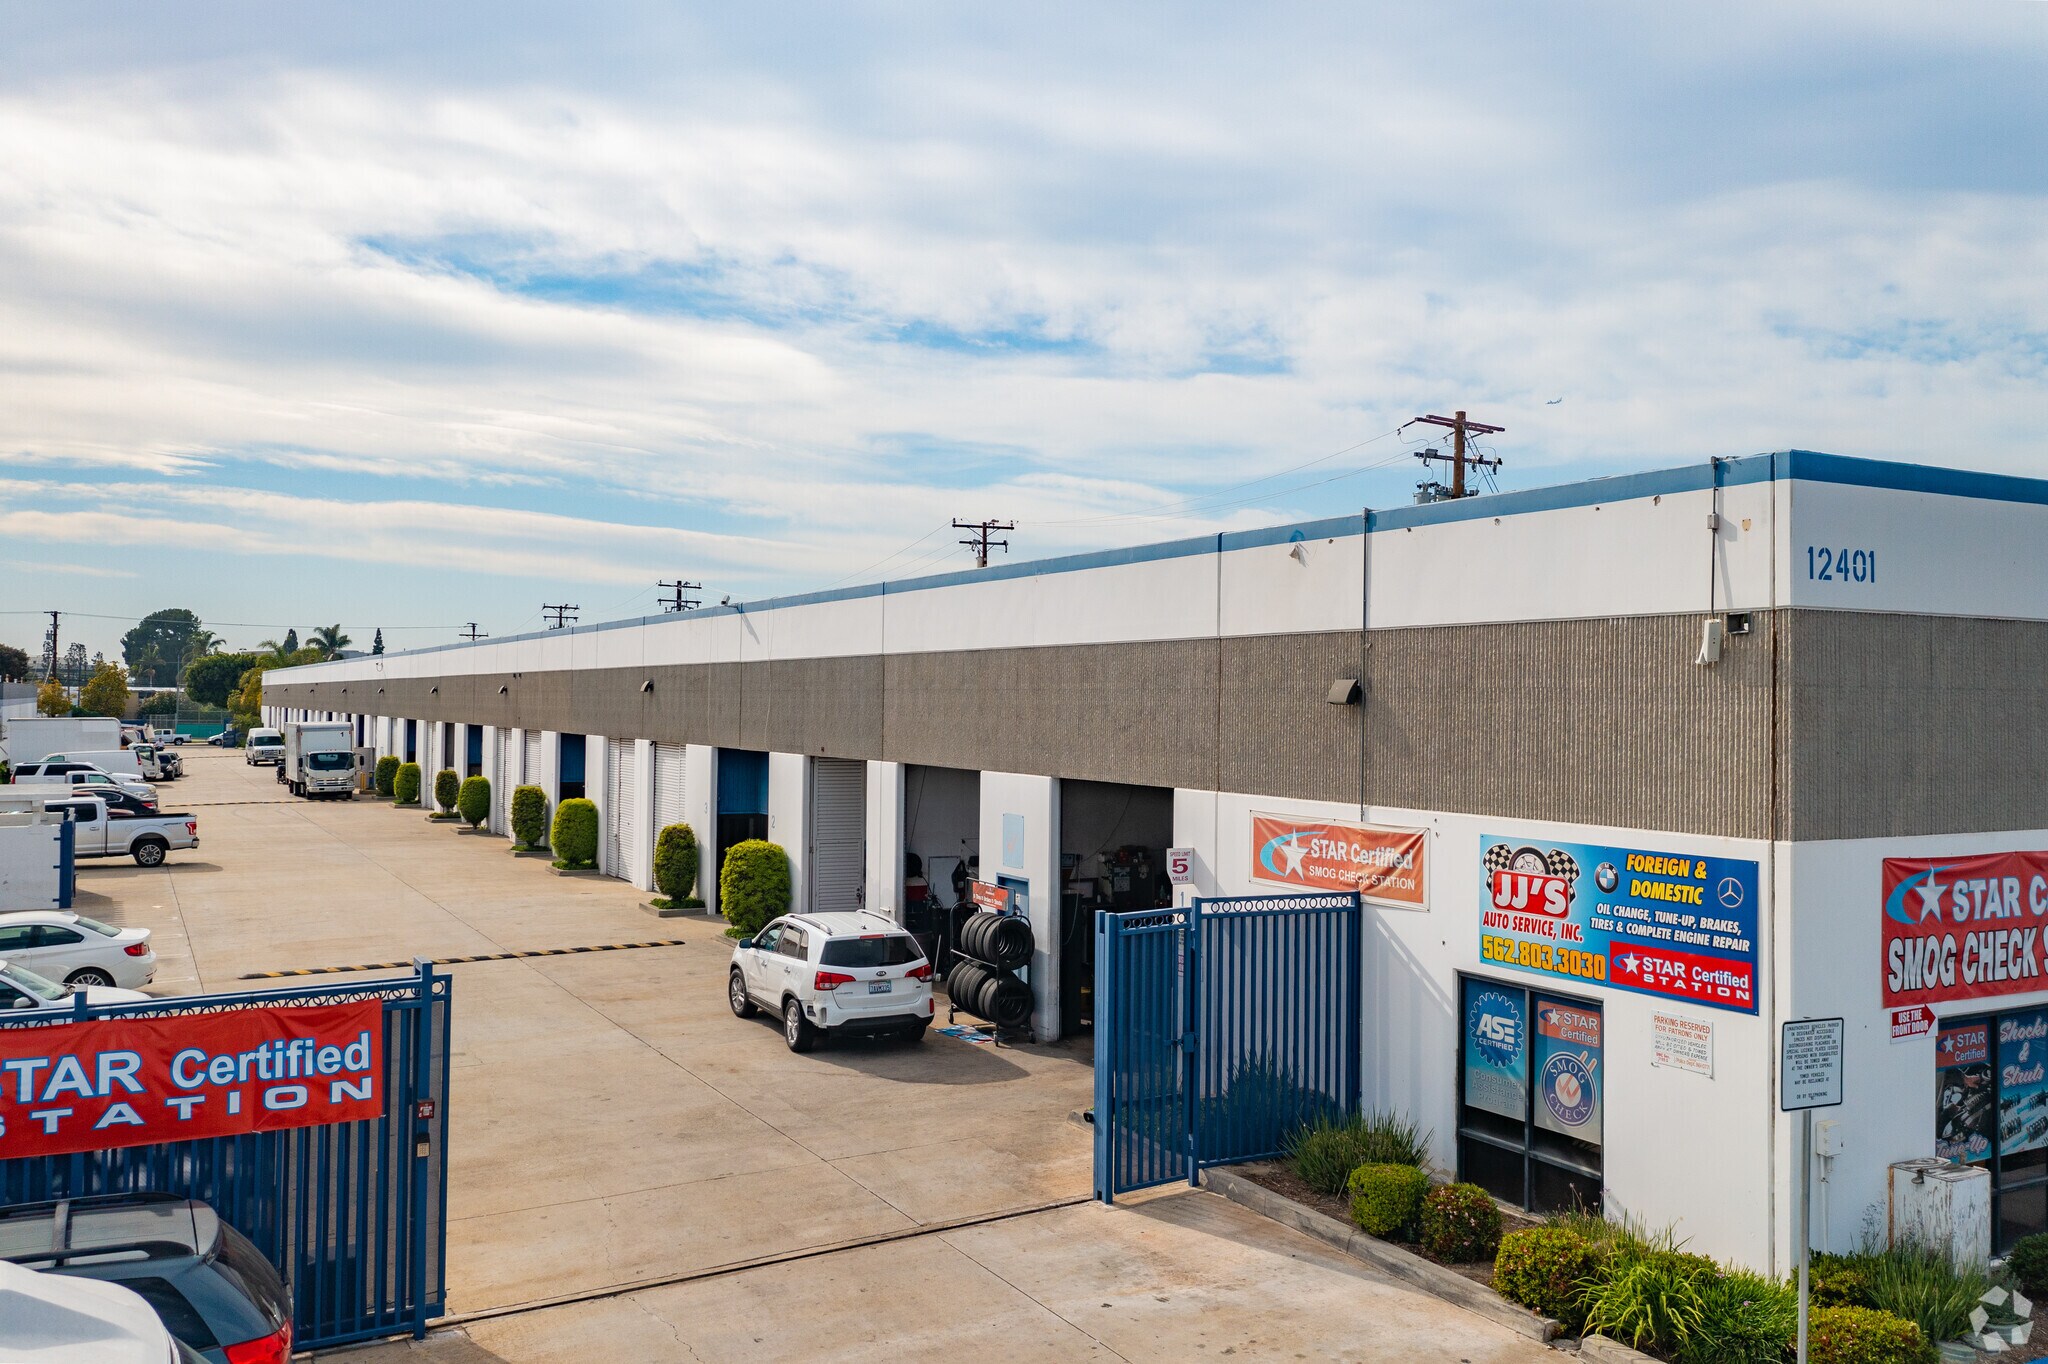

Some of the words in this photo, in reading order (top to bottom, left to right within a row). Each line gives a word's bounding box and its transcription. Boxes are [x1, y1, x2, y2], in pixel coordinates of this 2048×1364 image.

[1807, 546, 1875, 583] 12401
[1171, 858, 1188, 874] 5
[1310, 838, 1347, 862] STAR
[1350, 843, 1413, 870] Certified
[1626, 853, 1691, 877] FOREIGN
[1694, 861, 1707, 880] &
[1309, 865, 1336, 880] SMOG
[1338, 869, 1369, 885] CHECK
[1371, 874, 1415, 891] STATION
[1180, 891, 1184, 907] 1
[1494, 873, 1567, 915] JJ'S
[1630, 879, 1704, 905] DOMESTIC
[1952, 876, 2022, 922] STAR
[1483, 911, 1509, 930] AUTO
[1512, 915, 1557, 940] SERVICE,
[1561, 922, 1583, 942] INC.
[1596, 903, 1610, 915] OIL
[1613, 905, 1651, 922] CHANGE,
[1655, 911, 1696, 929] TUNE-UP,
[1700, 917, 1742, 935] BRAKES,
[1591, 917, 1613, 931] TIRES
[1615, 921, 1623, 933] &
[1626, 923, 1672, 941] COMPLETE
[1674, 930, 1710, 946] ENGINE
[1712, 935, 1750, 952] REPAIR
[1482, 934, 1606, 981] 562.803.3030
[1887, 932, 1956, 994] SMOG
[1961, 926, 2039, 985] CHECK
[1642, 957, 1686, 978] STAR
[1692, 966, 1749, 989] Certified
[1643, 973, 1750, 1000] STATION
[1475, 1013, 1515, 1044] ASE
[1563, 1011, 1598, 1031] STAR
[1654, 1014, 1678, 1028] PARKING
[1680, 1020, 1710, 1034] RESERVED
[1892, 1023, 1911, 1037] FRONT
[1911, 1020, 1929, 1033] DOOR
[1898, 1011, 1910, 1023] USE
[1910, 1009, 1923, 1021] THE
[2000, 1015, 2048, 1043] Shocks
[1478, 1038, 1514, 1052] CERTIFIED
[1560, 1026, 1598, 1045] Certified
[1655, 1024, 1667, 1032] FOR
[1668, 1027, 1692, 1038] PATRONS
[1693, 1033, 1708, 1042] ONLY
[1957, 1031, 1985, 1048] STAR
[1954, 1048, 1986, 1062] Certified
[2018, 1041, 2030, 1062] &
[0, 1050, 147, 1104] TAR
[171, 1030, 371, 1089] Certified
[1474, 1069, 1521, 1090] Consumer
[1549, 1059, 1587, 1084] SMOG
[2002, 1062, 2045, 1088] Struts
[1472, 1081, 1523, 1101] Assistance
[1549, 1093, 1588, 1121] CHECK
[1936, 1134, 1988, 1158] Tune-Up
